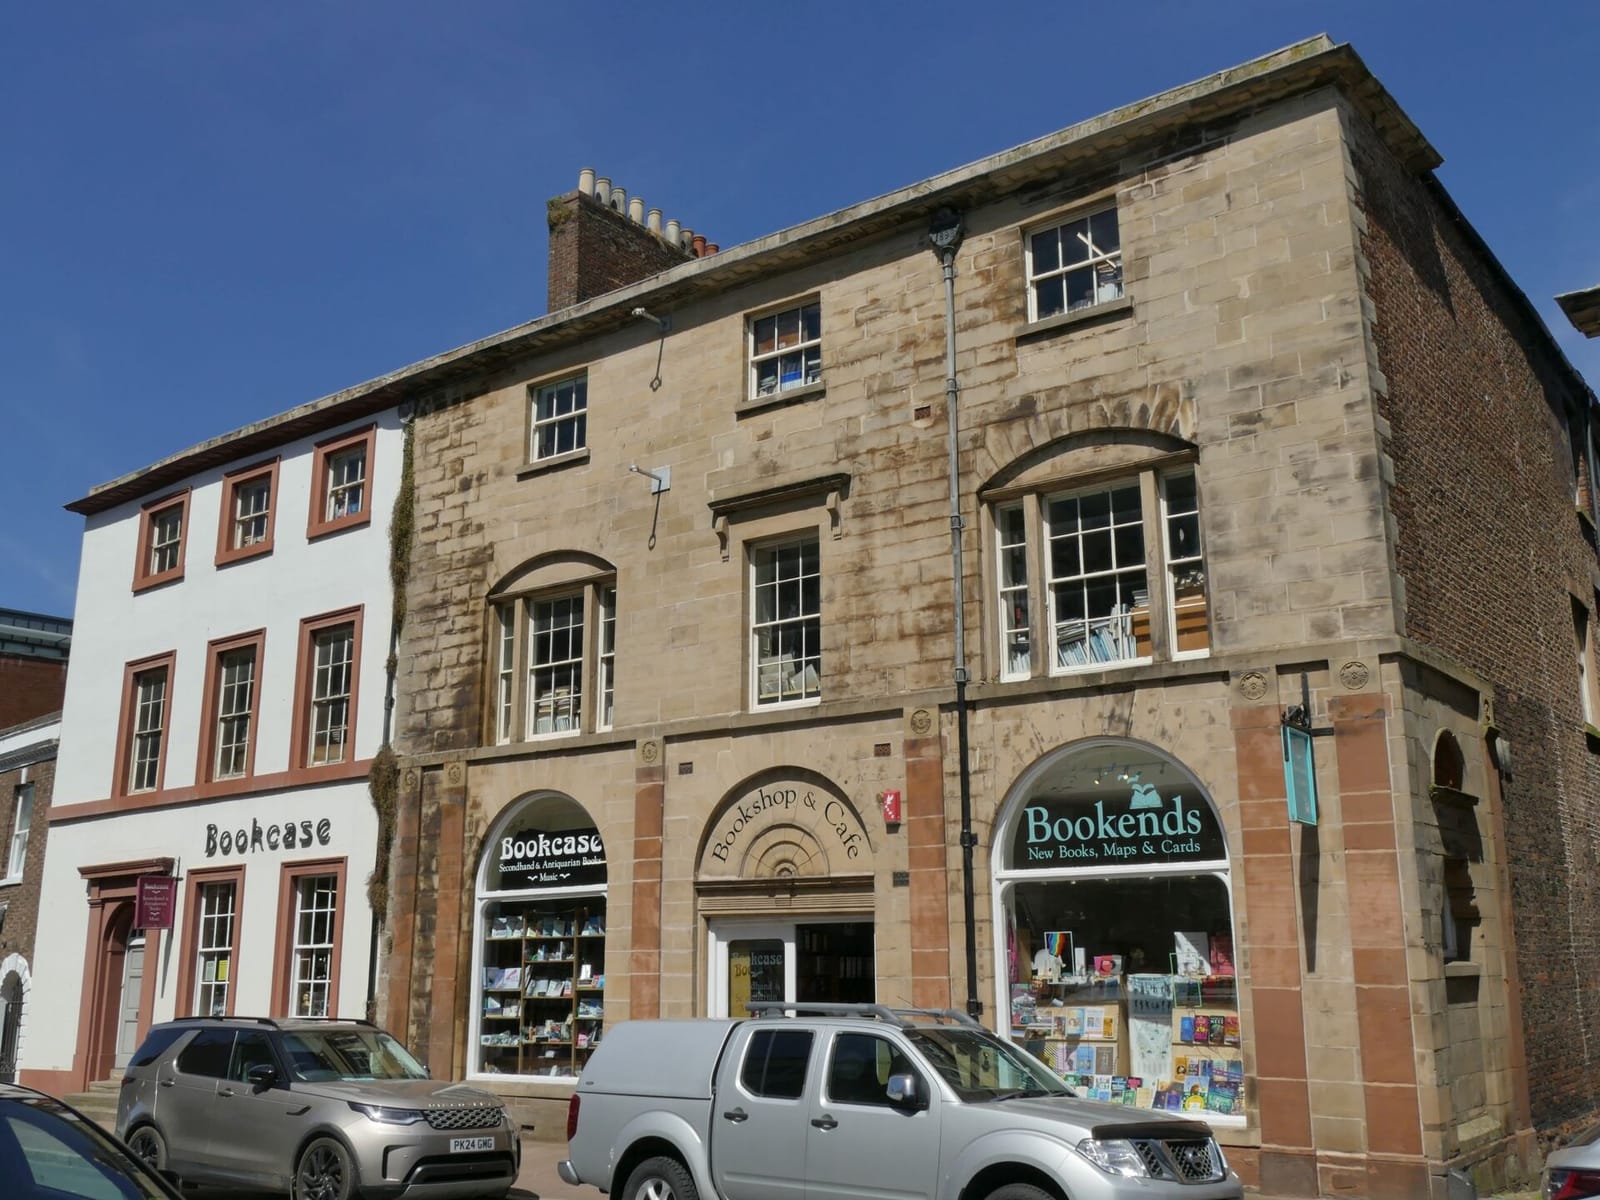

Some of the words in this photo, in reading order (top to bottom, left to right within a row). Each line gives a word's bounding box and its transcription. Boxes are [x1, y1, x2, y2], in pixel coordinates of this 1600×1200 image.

[712, 788, 796, 863] Bookshop
[803, 791, 817, 811] &
[825, 801, 862, 859] Cafe
[1024, 795, 1202, 844] Bookends
[205, 817, 331, 858] Bookcase
[500, 834, 602, 860] Bookcase
[1028, 846, 1054, 861] New
[1059, 844, 1099, 859] Books,
[1103, 842, 1137, 859] Maps
[1142, 841, 1156, 854] &
[1161, 838, 1201, 854] Cards
[499, 862, 535, 872] Secondhand
[542, 859, 581, 870] Antiquarian
[540, 872, 559, 882] Music
[454, 1140, 476, 1151] PK24
